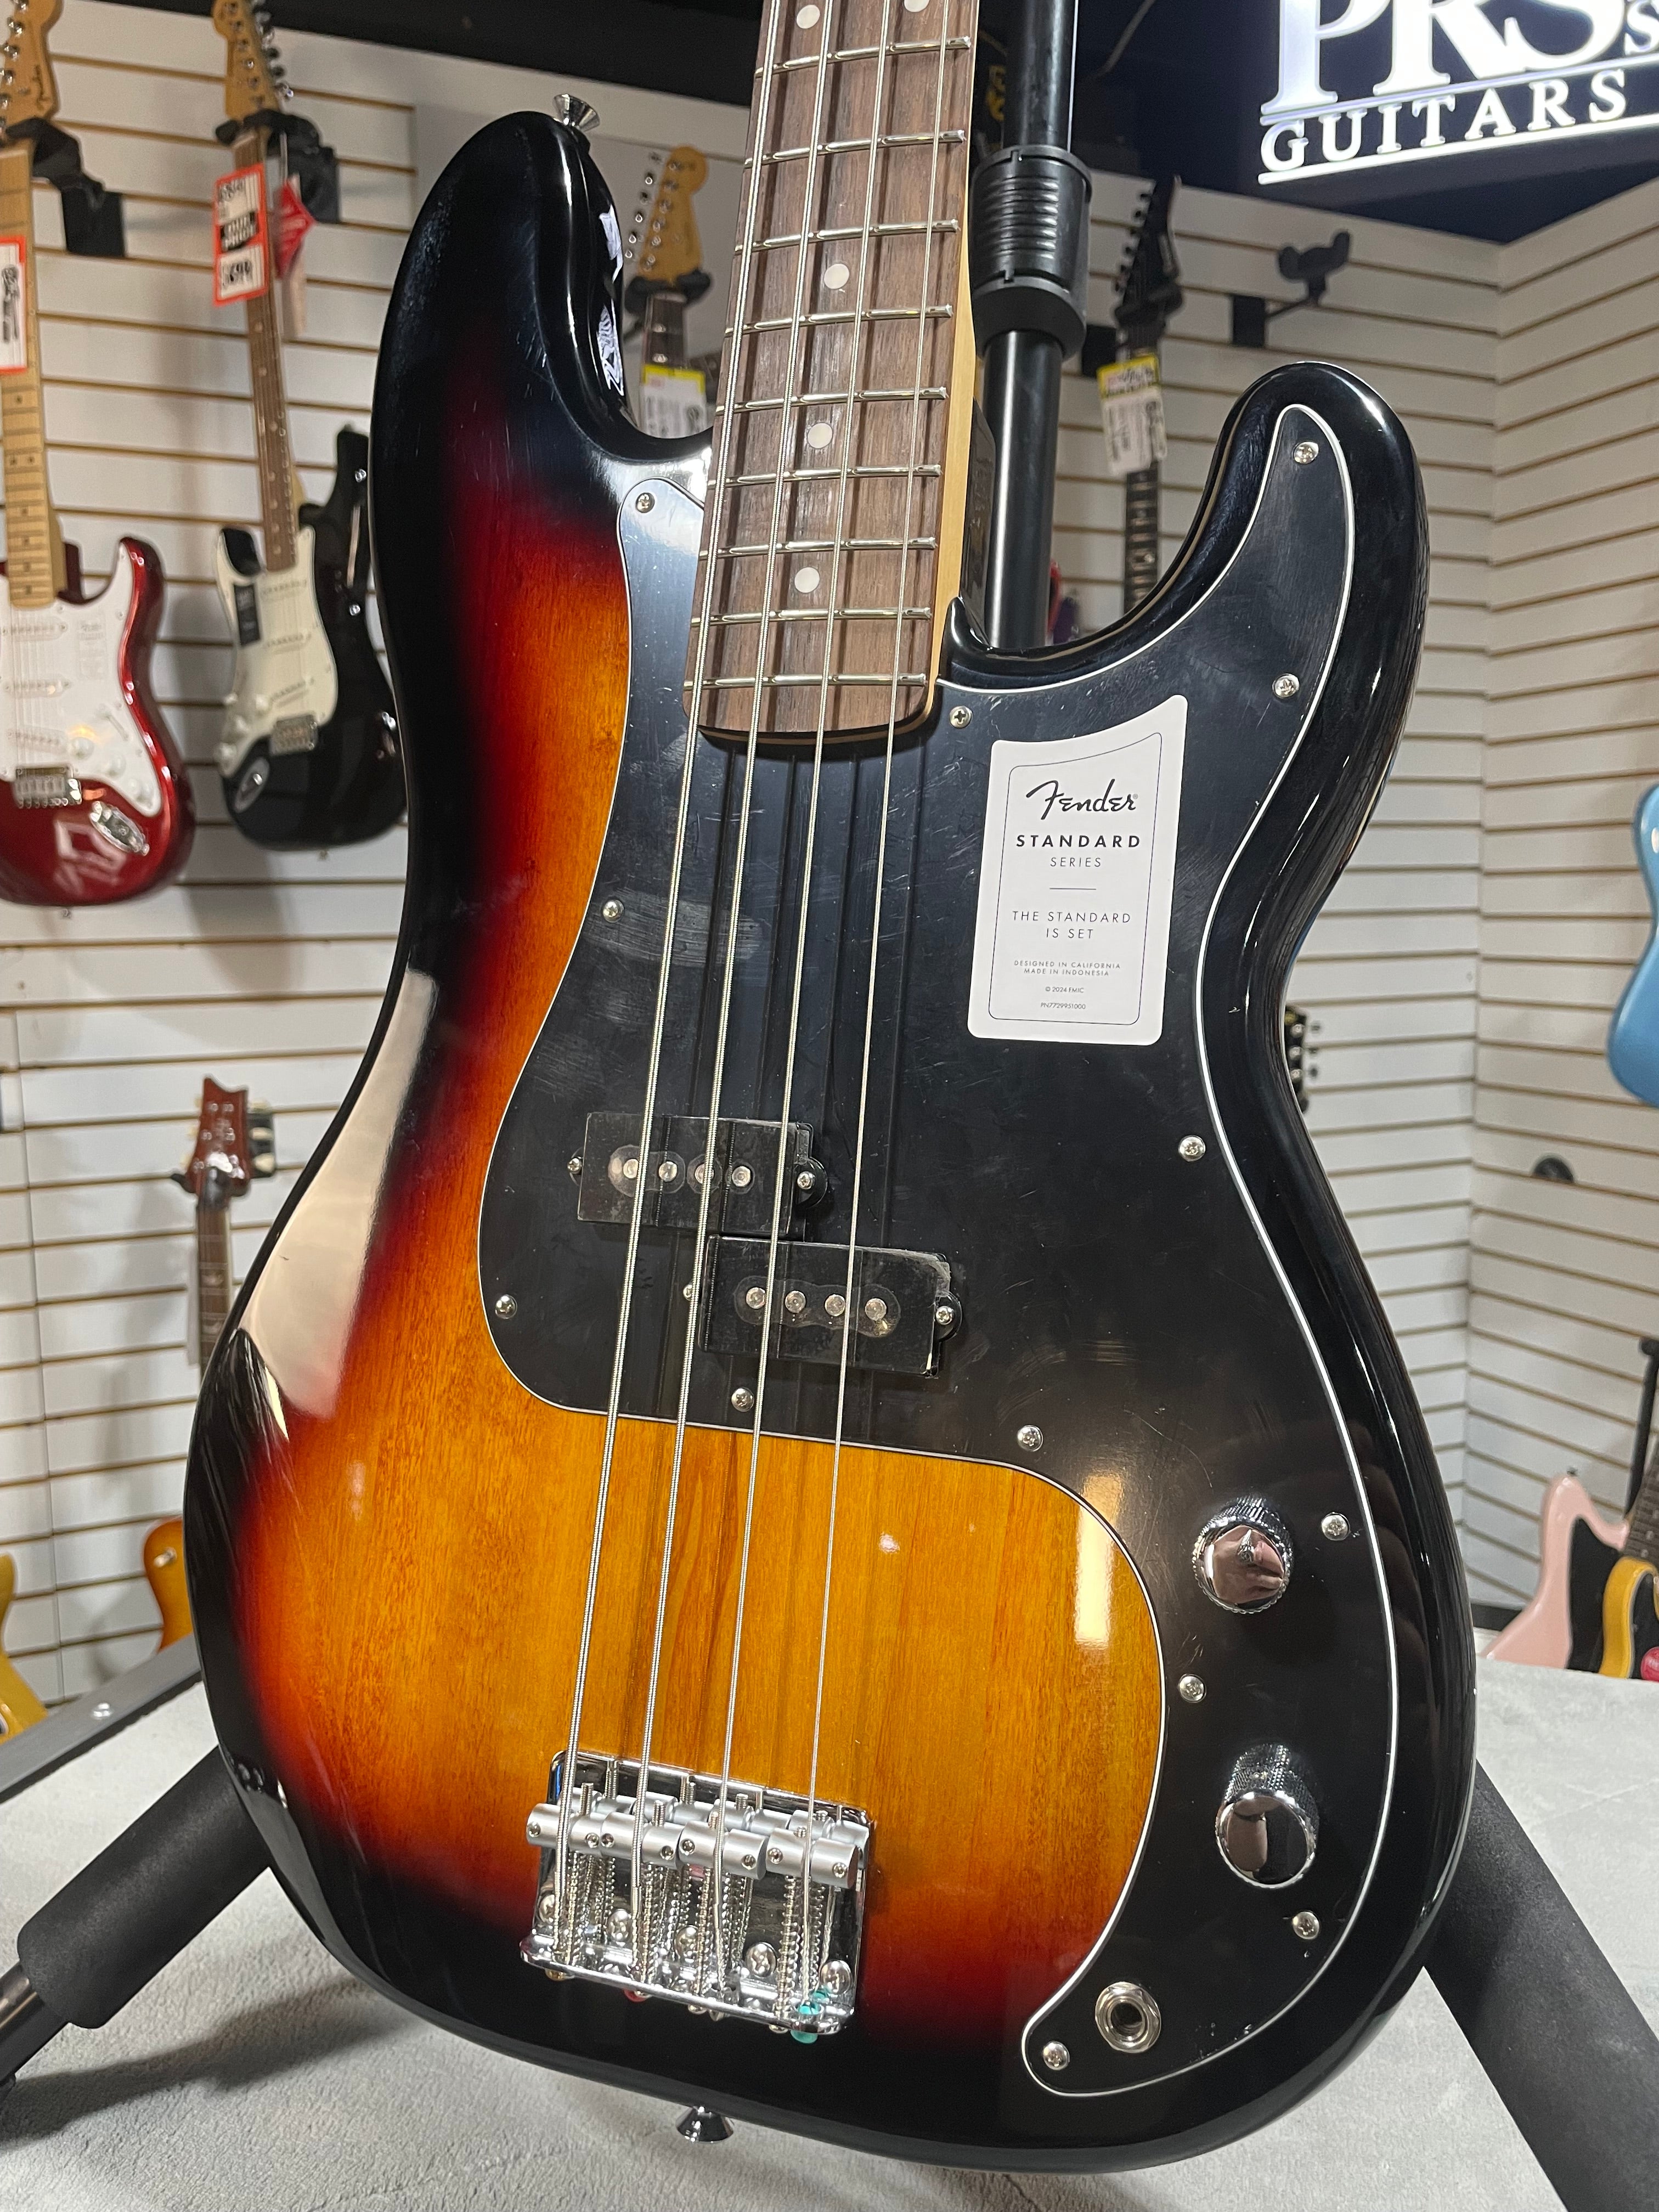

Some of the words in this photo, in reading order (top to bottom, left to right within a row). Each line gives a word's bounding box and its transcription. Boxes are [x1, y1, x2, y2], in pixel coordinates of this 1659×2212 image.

[1261, 68, 1627, 172] GUITARS
[1025, 778, 1137, 820] Fender
[1016, 834, 1141, 848] STANDARD
[1050, 857, 1102, 867] SERIES
[1013, 911, 1039, 922] THE
[1047, 911, 1131, 923] STANDARD
[1046, 928, 1059, 938] IS
[1068, 928, 1093, 939] SET
